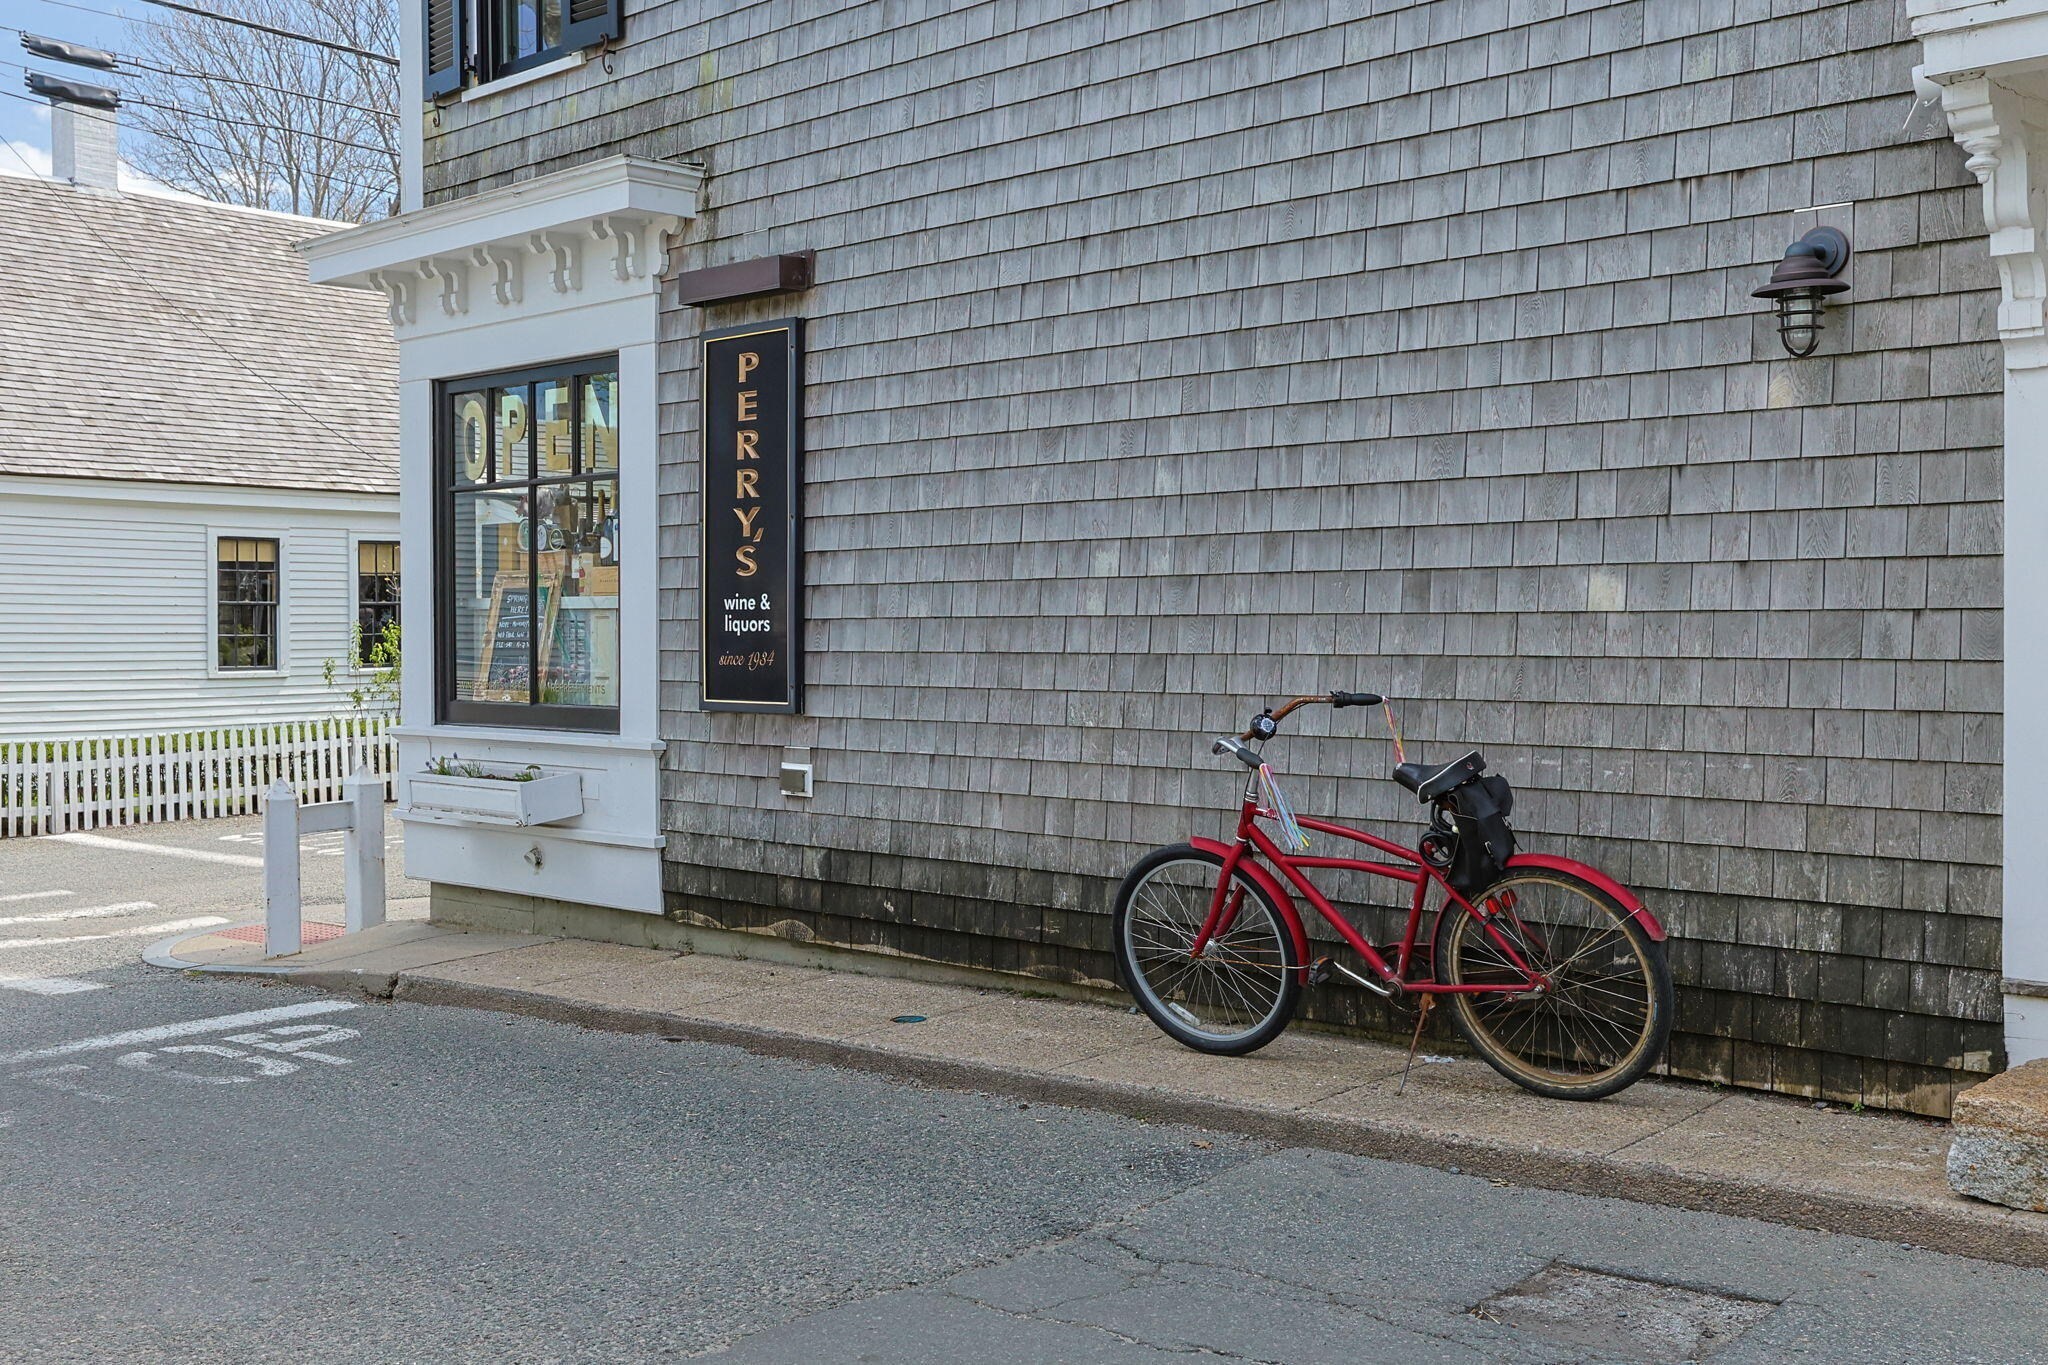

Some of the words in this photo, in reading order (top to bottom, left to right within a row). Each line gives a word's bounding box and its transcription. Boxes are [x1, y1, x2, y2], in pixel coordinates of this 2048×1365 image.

[464, 380, 618, 481] OPEN
[733, 351, 763, 578] PERRY'S
[723, 593, 756, 611] wine
[760, 592, 771, 610] &
[723, 613, 771, 637] liquors
[718, 650, 744, 668] since
[747, 649, 776, 671] 1934
